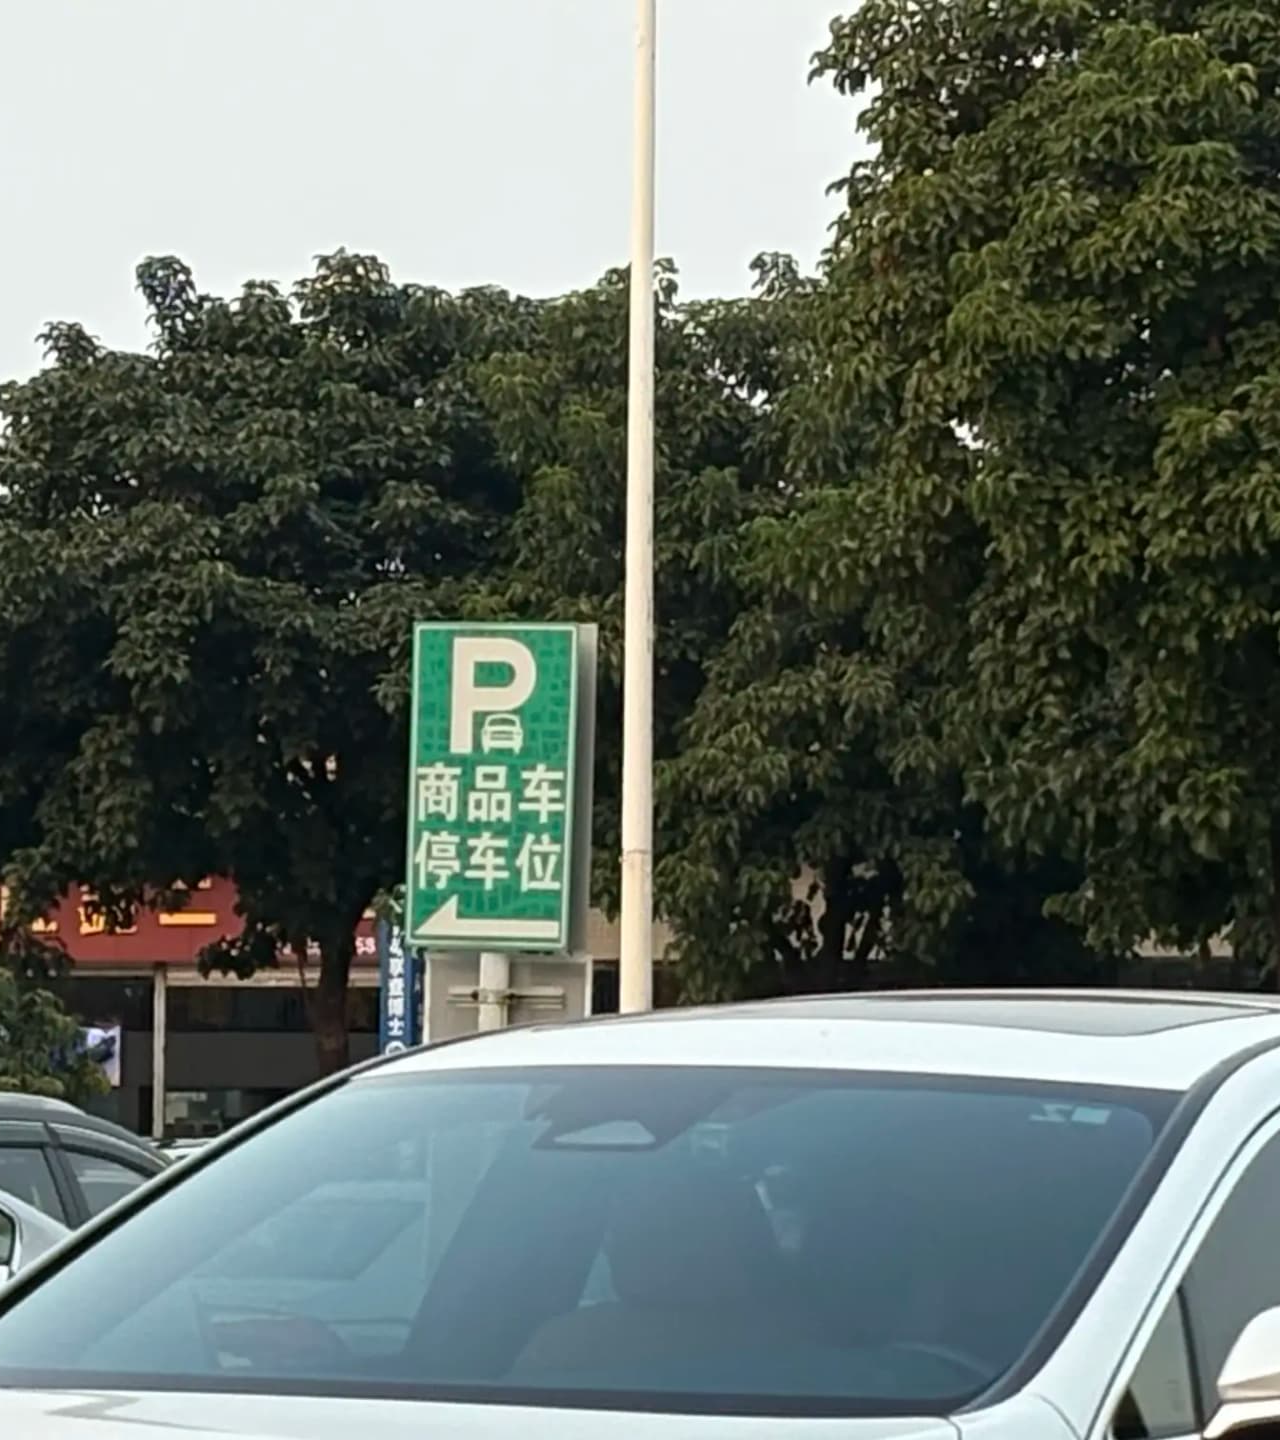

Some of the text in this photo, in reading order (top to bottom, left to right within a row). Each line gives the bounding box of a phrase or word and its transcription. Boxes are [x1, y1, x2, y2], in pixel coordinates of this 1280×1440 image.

[449, 636, 537, 754] P
[416, 762, 565, 824] 商品车
[414, 831, 561, 892] 停车位
